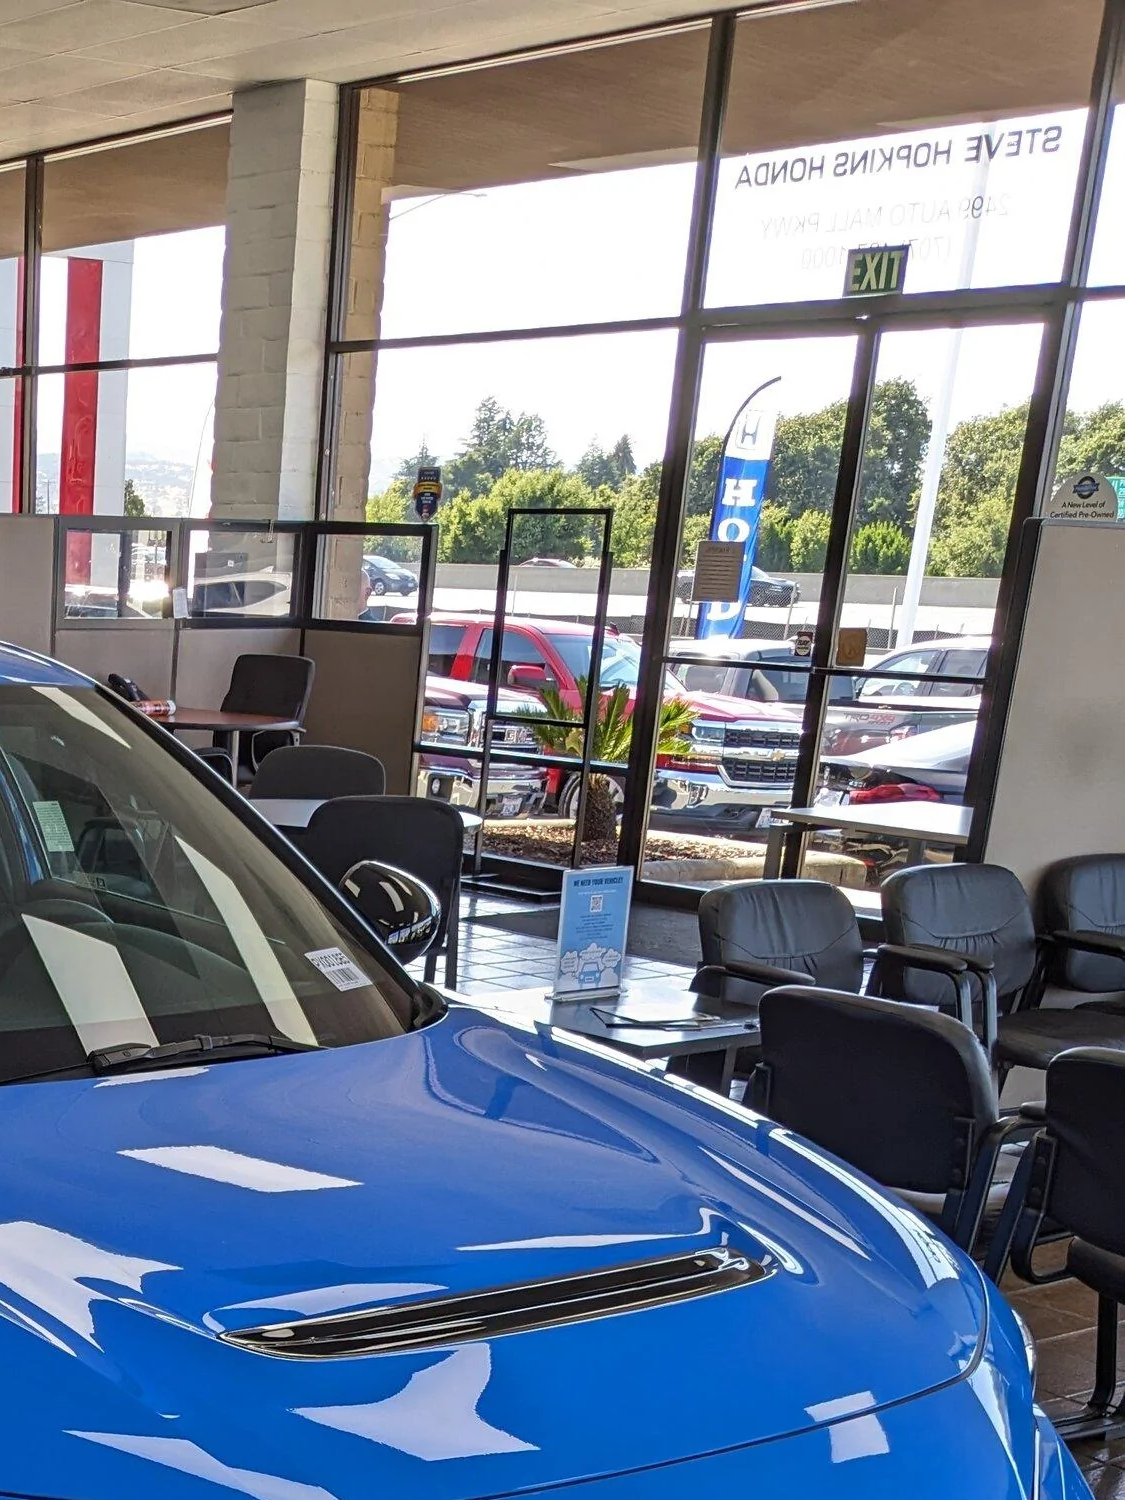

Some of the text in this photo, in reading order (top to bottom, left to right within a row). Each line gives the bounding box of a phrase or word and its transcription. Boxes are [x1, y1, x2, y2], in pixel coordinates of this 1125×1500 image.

[849, 250, 904, 292] EXIT
[1082, 501, 1098, 509] Level
[1098, 500, 1106, 508] of
[1050, 511, 1114, 519] Certified Pre-Owned
